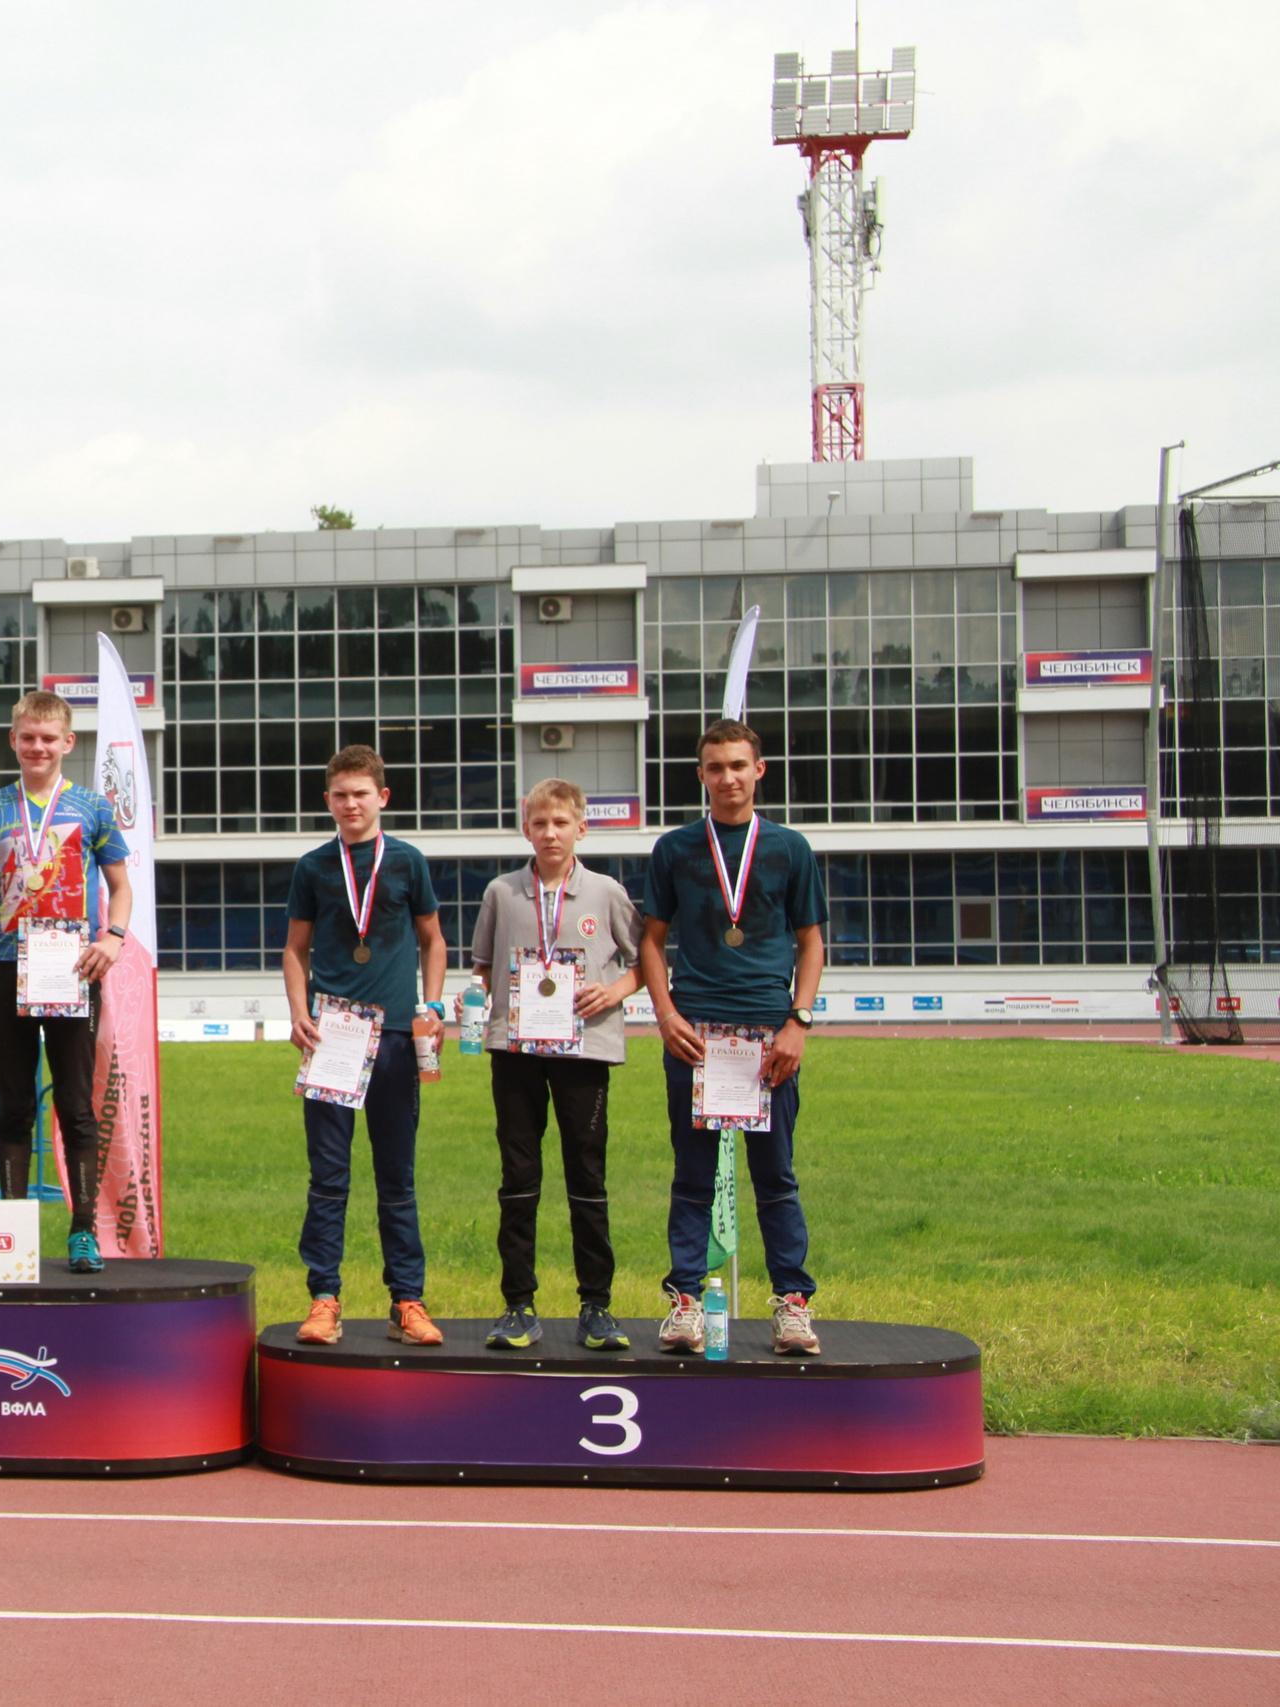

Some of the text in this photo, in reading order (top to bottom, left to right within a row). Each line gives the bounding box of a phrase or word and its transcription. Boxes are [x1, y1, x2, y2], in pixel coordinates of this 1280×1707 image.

[1042, 661, 1139, 673] ЧЕЛЯБИНСК
[535, 673, 626, 685] ЧЕЛЯБИНСК
[1043, 797, 1140, 809] ЧЕЛЯБИНСК
[526, 972, 569, 980] ГРАМОТА
[325, 1020, 365, 1034] ГРАМОТА
[711, 1047, 756, 1057] ГРАМОТА
[0, 1401, 46, 1416] ВФЛА
[578, 1385, 642, 1455] 3
